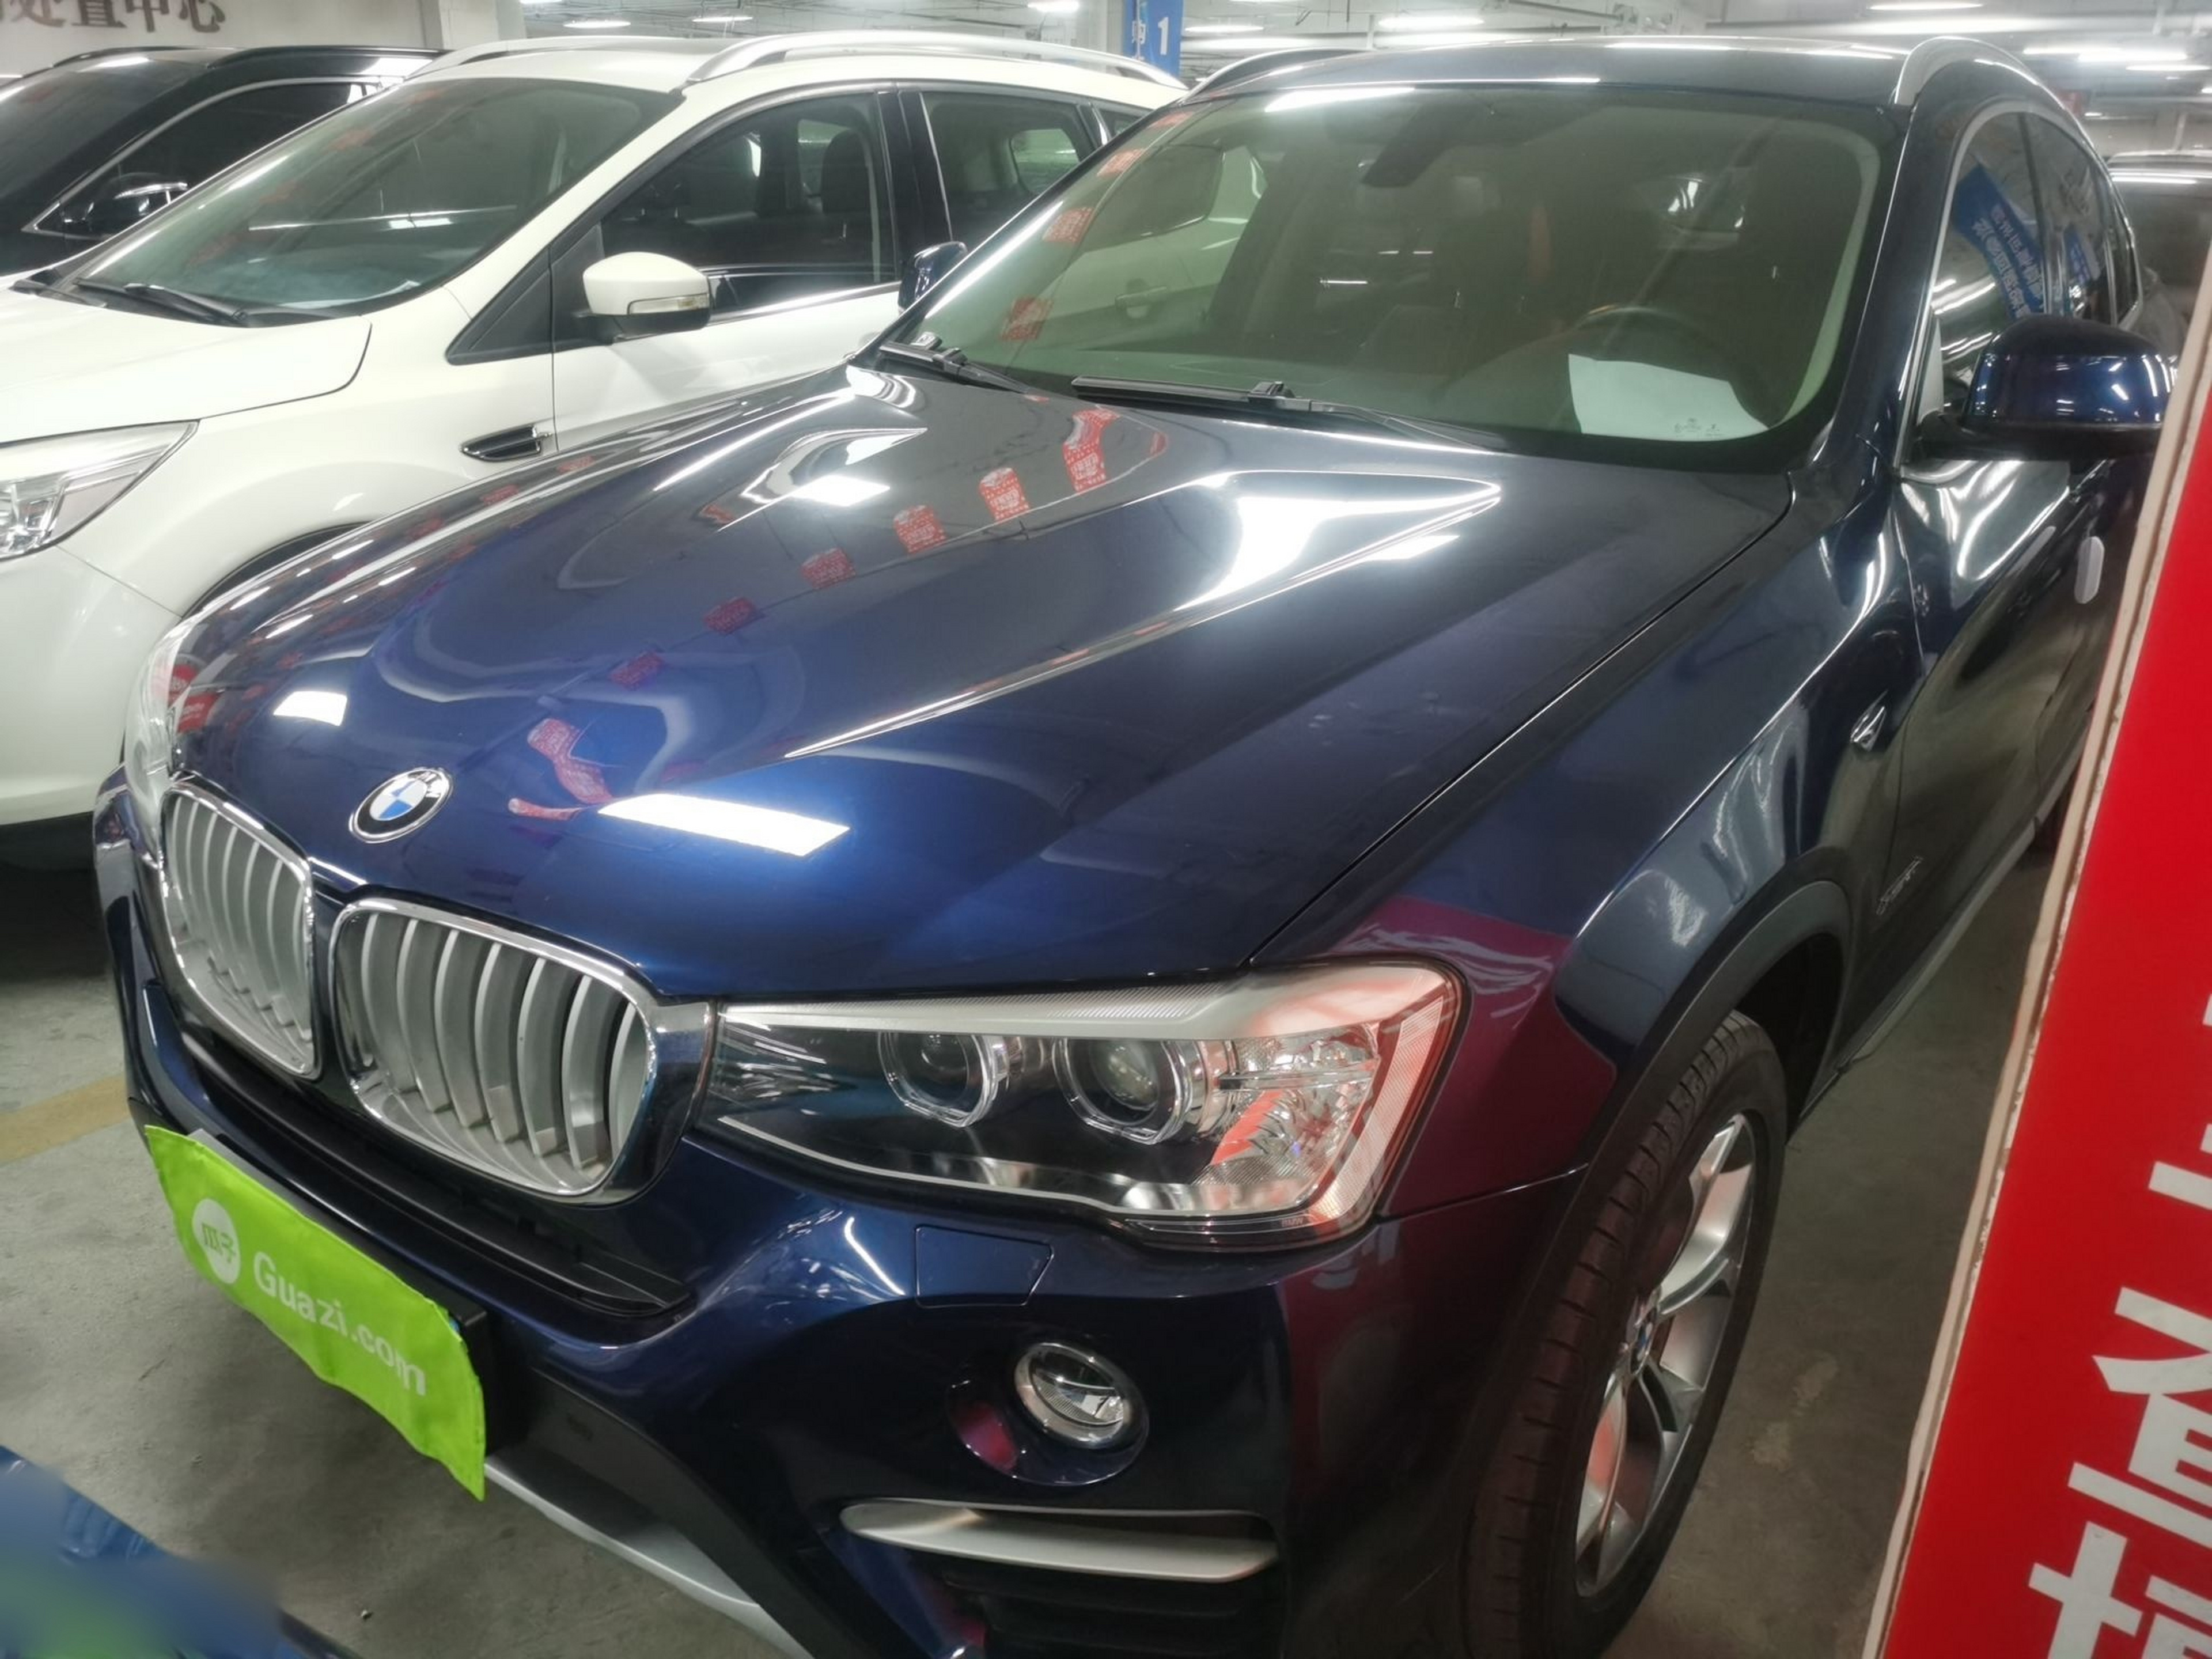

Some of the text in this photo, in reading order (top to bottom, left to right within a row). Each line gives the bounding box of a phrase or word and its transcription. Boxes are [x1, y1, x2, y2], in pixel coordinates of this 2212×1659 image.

[0, 0, 226, 33] 处置中心
[253, 1251, 426, 1397] Guazi.com
